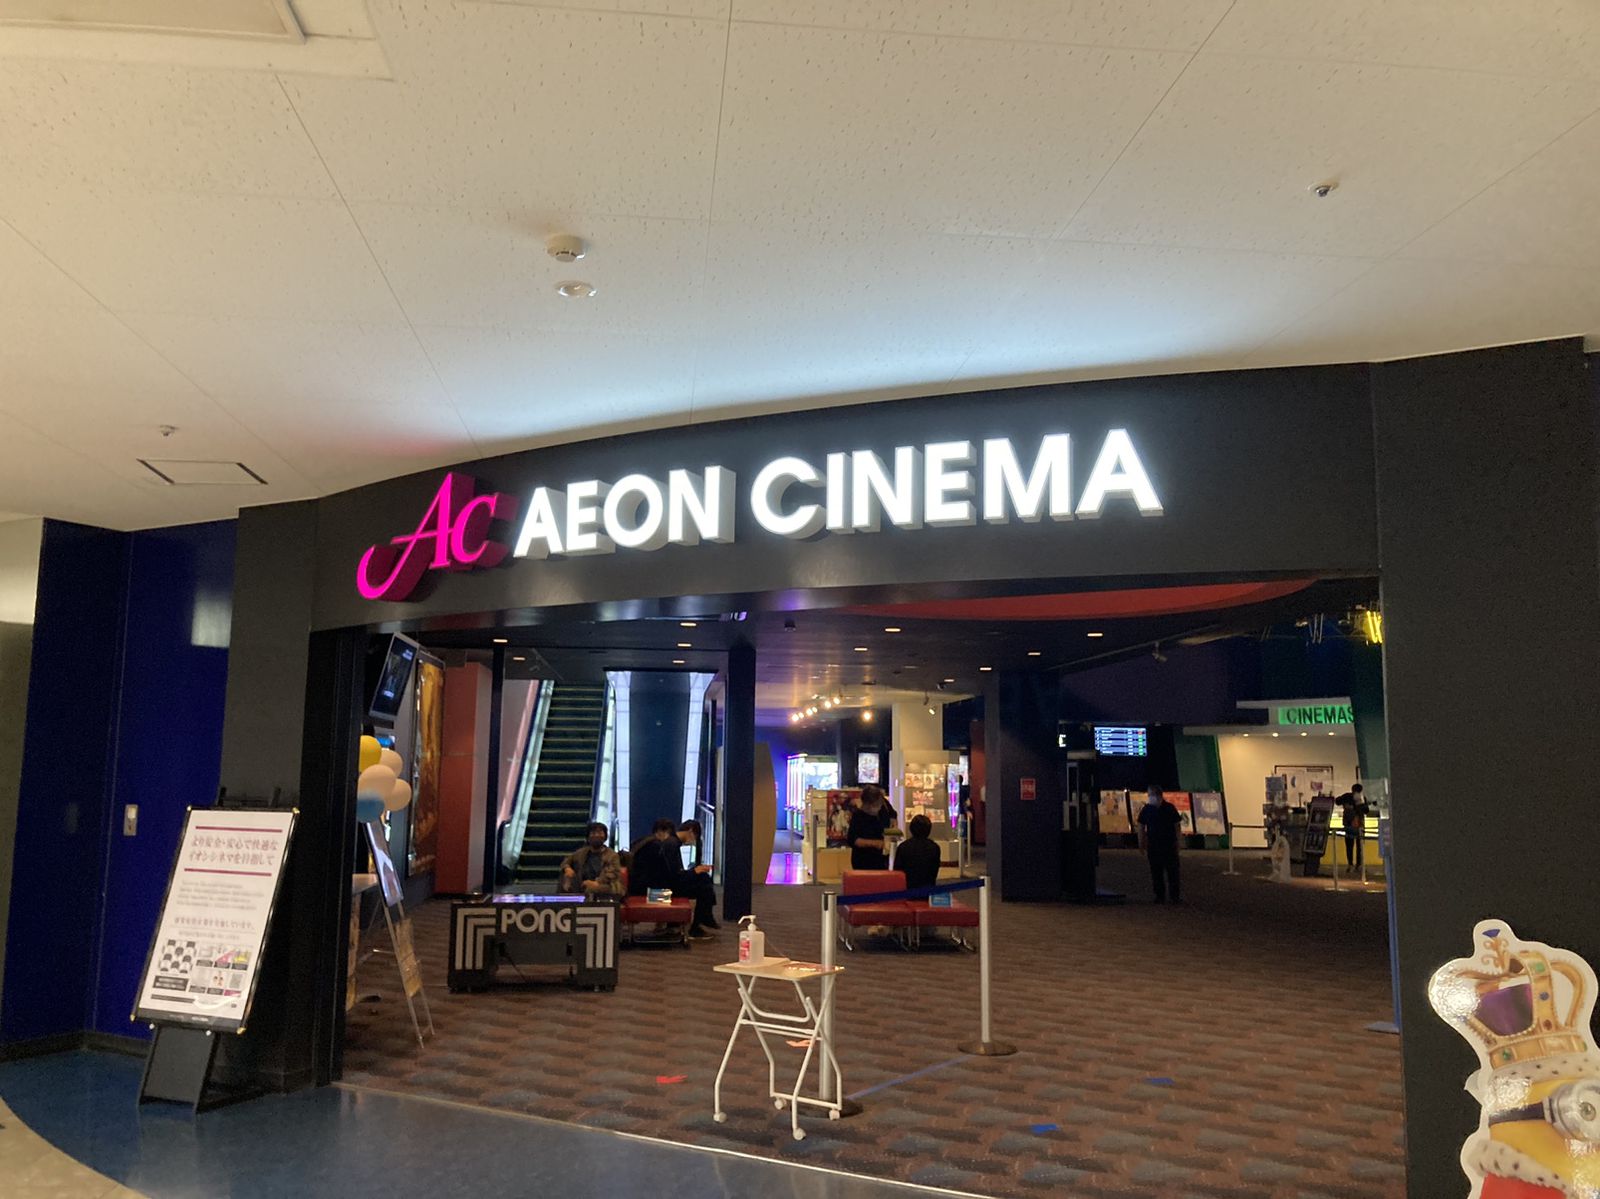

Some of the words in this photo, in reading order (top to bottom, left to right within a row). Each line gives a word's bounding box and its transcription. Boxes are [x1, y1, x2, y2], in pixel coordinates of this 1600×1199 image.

[512, 464, 732, 559] AEON
[751, 428, 1164, 537] CINEMA
[1286, 705, 1355, 724] CINEMAS
[501, 908, 571, 933] PONG
